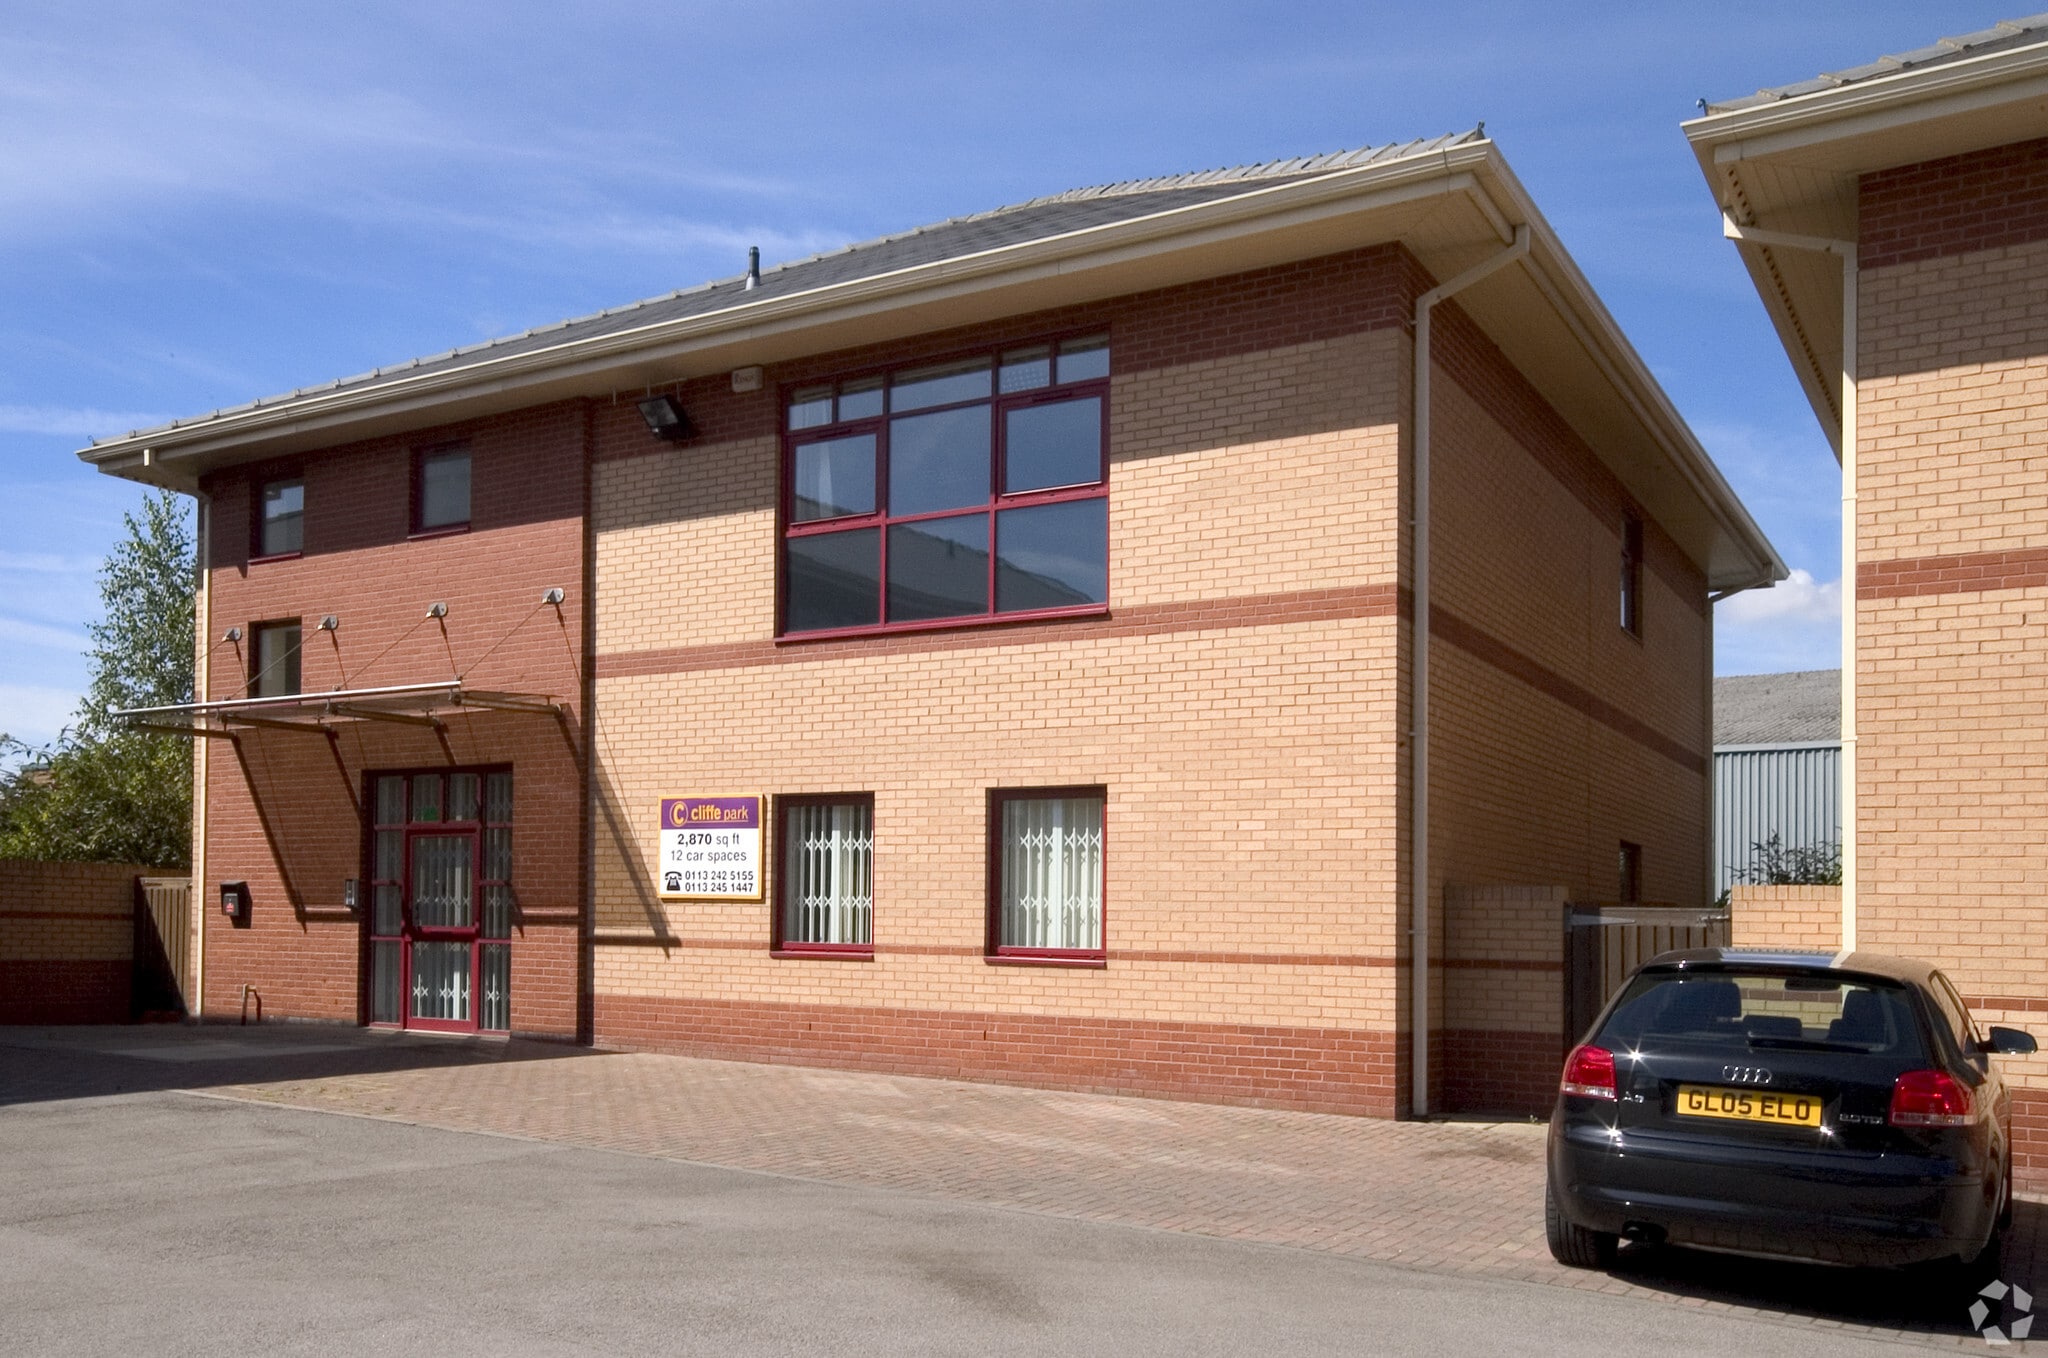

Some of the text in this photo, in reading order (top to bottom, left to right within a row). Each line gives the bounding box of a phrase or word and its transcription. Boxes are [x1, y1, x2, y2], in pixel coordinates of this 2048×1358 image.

[691, 805, 721, 820] cliffe
[723, 805, 749, 821] park
[677, 832, 740, 847] 2,870 sq ft
[671, 849, 747, 864] 12 car spaces
[685, 871, 754, 880] 0113 242 5155
[685, 882, 753, 892] 0113 245 1447
